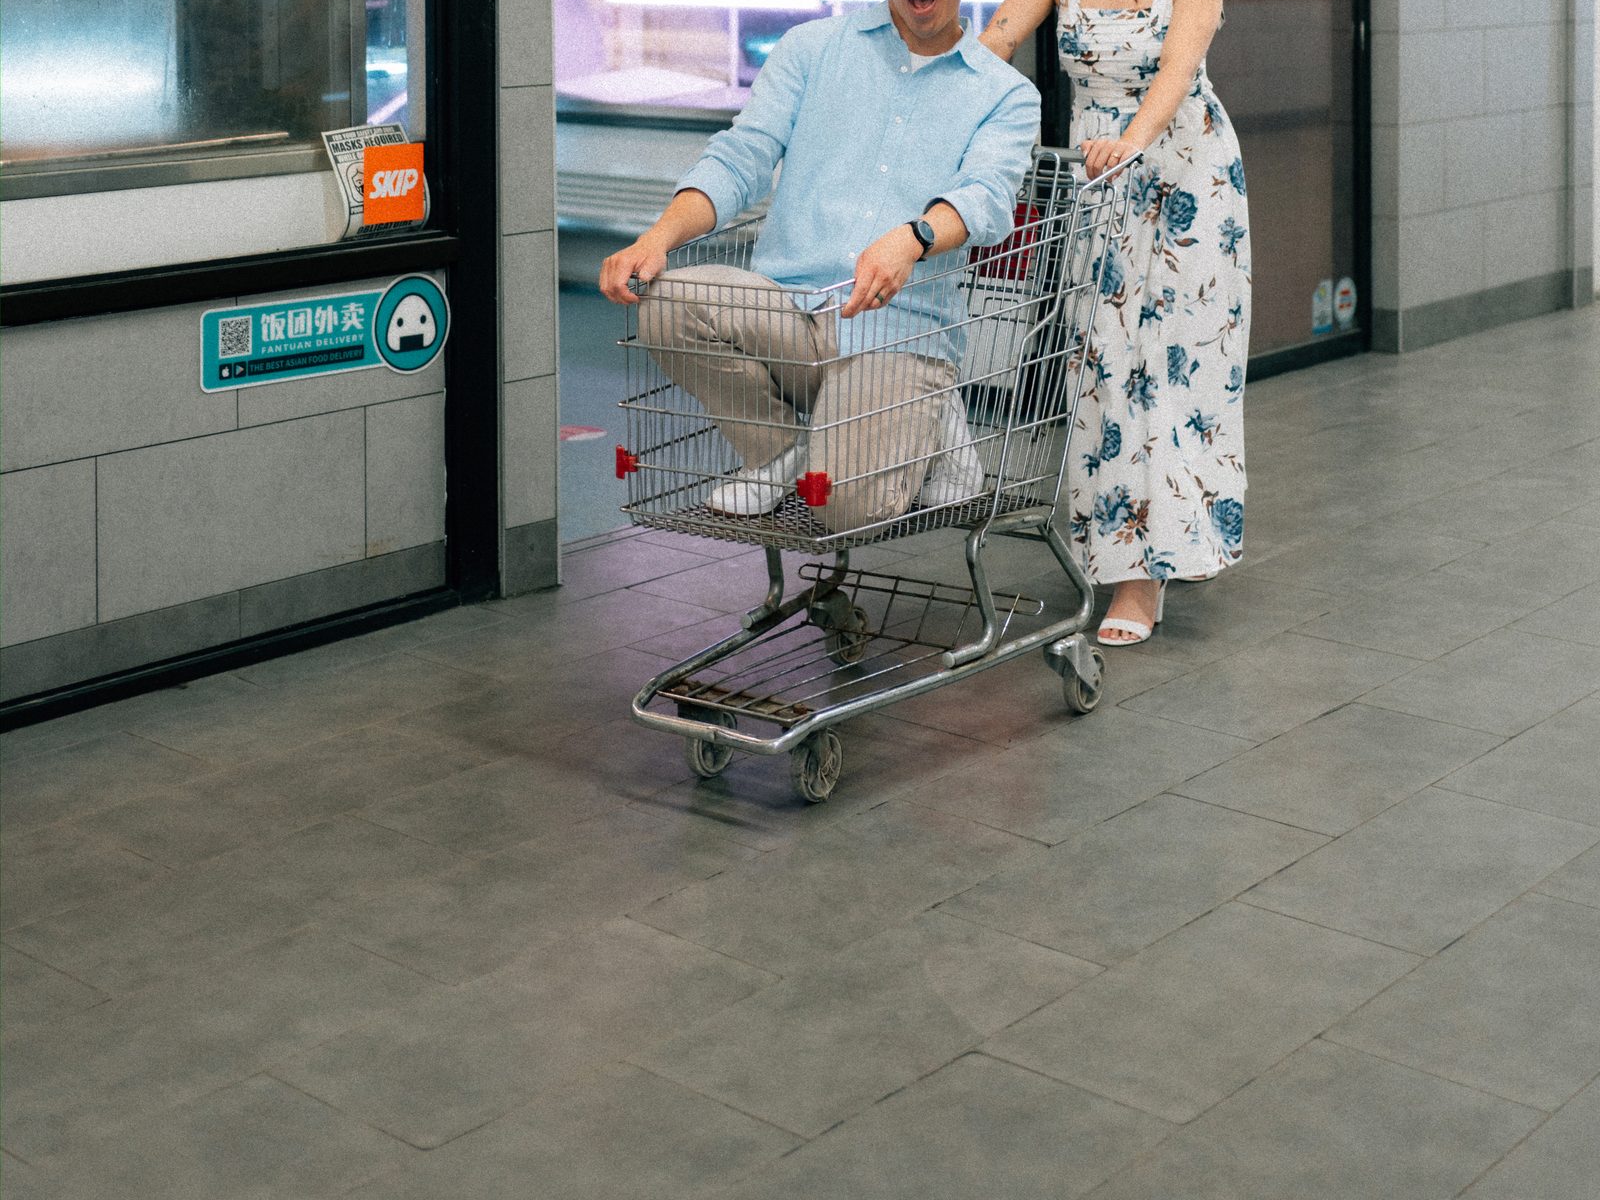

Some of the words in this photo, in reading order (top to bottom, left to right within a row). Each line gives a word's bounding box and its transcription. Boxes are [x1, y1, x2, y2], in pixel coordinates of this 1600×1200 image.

[331, 139, 363, 153] MASKS
[365, 133, 404, 147] REQUIRED
[369, 168, 419, 199] SKIP
[260, 302, 365, 342] 饭团外卖
[261, 340, 312, 354] FANTUAN
[316, 333, 364, 347] DELIVERY
[250, 362, 265, 372] THE
[266, 360, 284, 370] BEST
[285, 356, 307, 367] ASIAN
[308, 354, 329, 365] FOOD
[330, 349, 363, 361] DELIVERY
